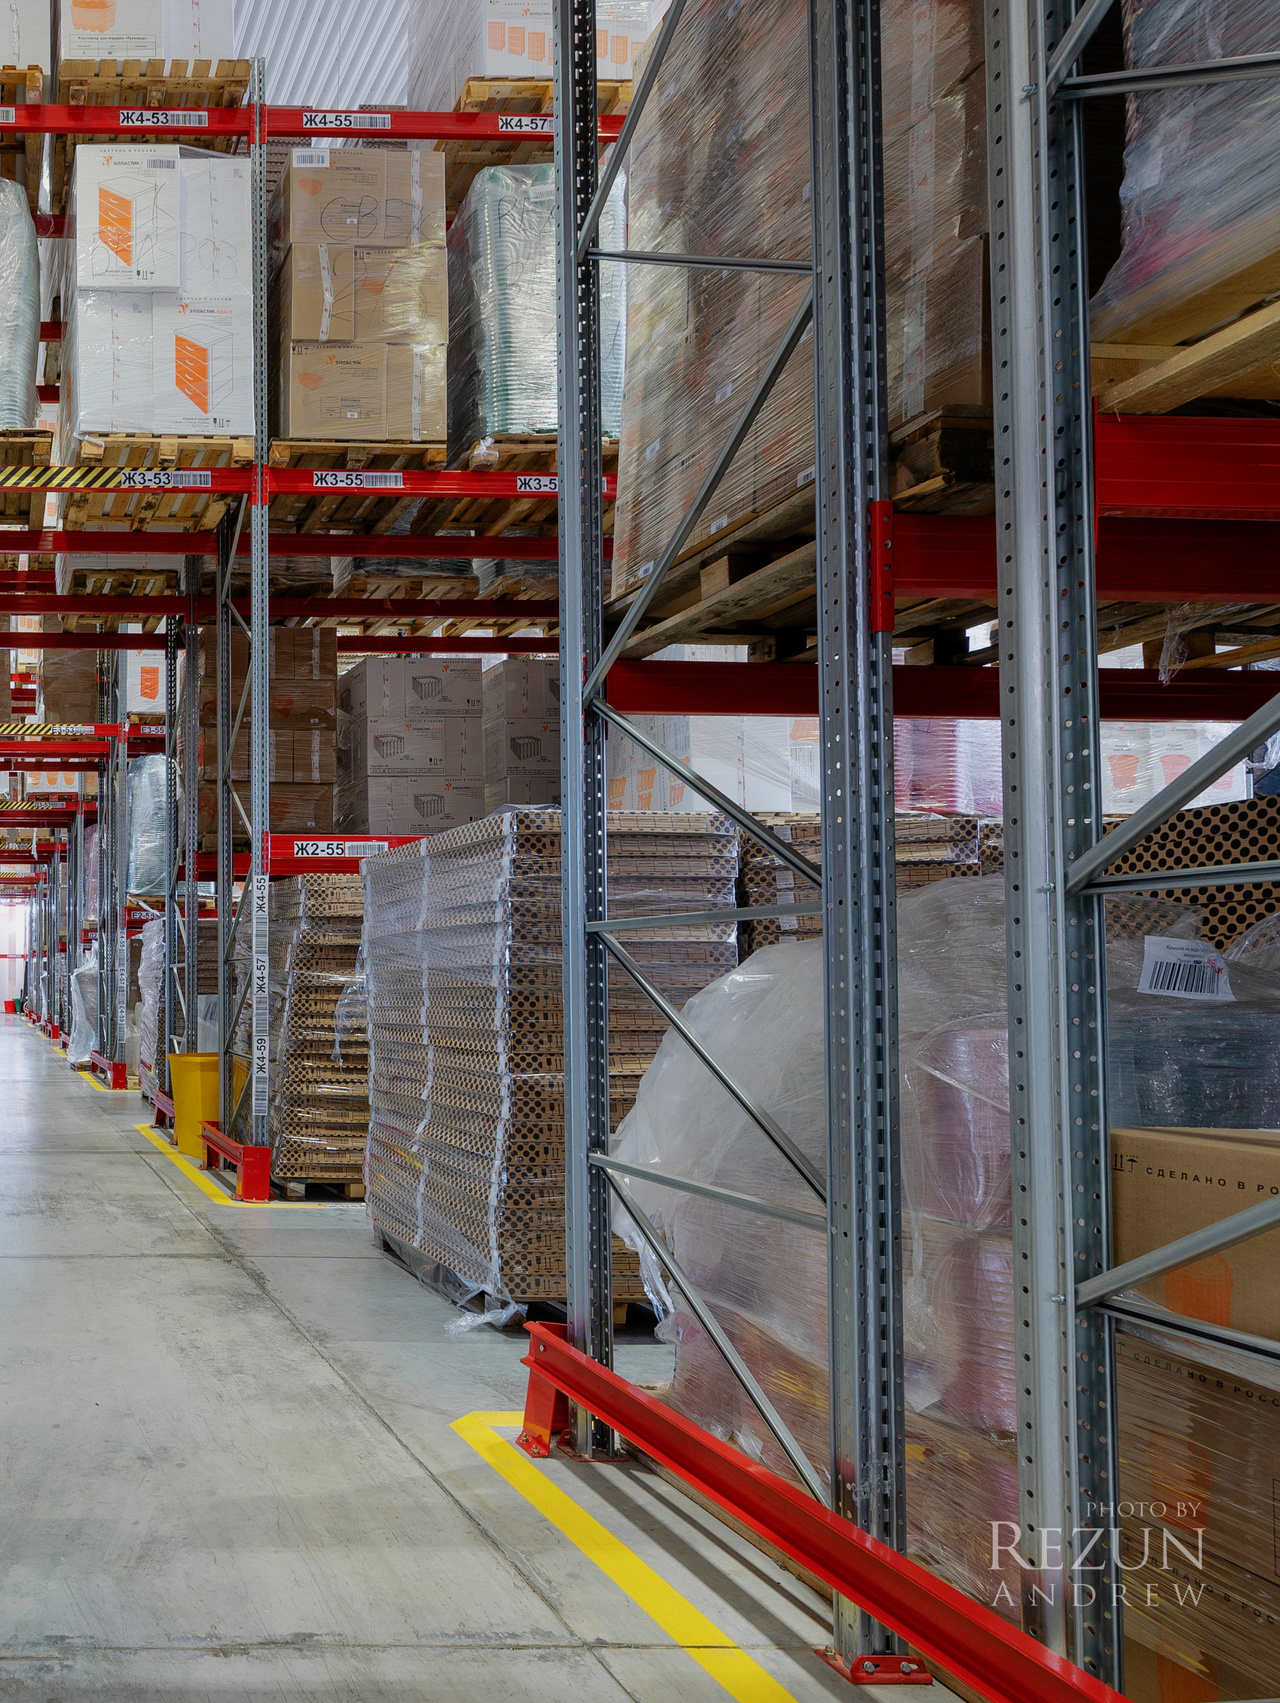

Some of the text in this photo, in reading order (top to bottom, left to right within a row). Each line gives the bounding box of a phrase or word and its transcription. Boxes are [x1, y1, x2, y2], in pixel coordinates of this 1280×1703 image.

[120, 111, 169, 124] Ж4-53
[303, 114, 353, 128] Ж4-55
[499, 117, 547, 131] Ж4-57
[122, 471, 171, 485] Ж3-53
[314, 472, 363, 486] Ж3-55
[518, 477, 558, 491] Ж3-5
[295, 843, 345, 856] Ж2-55
[255, 877, 266, 913] Ж4-55
[255, 958, 266, 994] Ж4-57
[255, 1038, 266, 1074] Ж4-59
[1146, 1167, 1226, 1187] СДЕЛАНО
[1237, 1181, 1245, 1189] В
[1134, 1352, 1206, 1383] СДЕЛАНО
[1216, 1380, 1224, 1388] В
